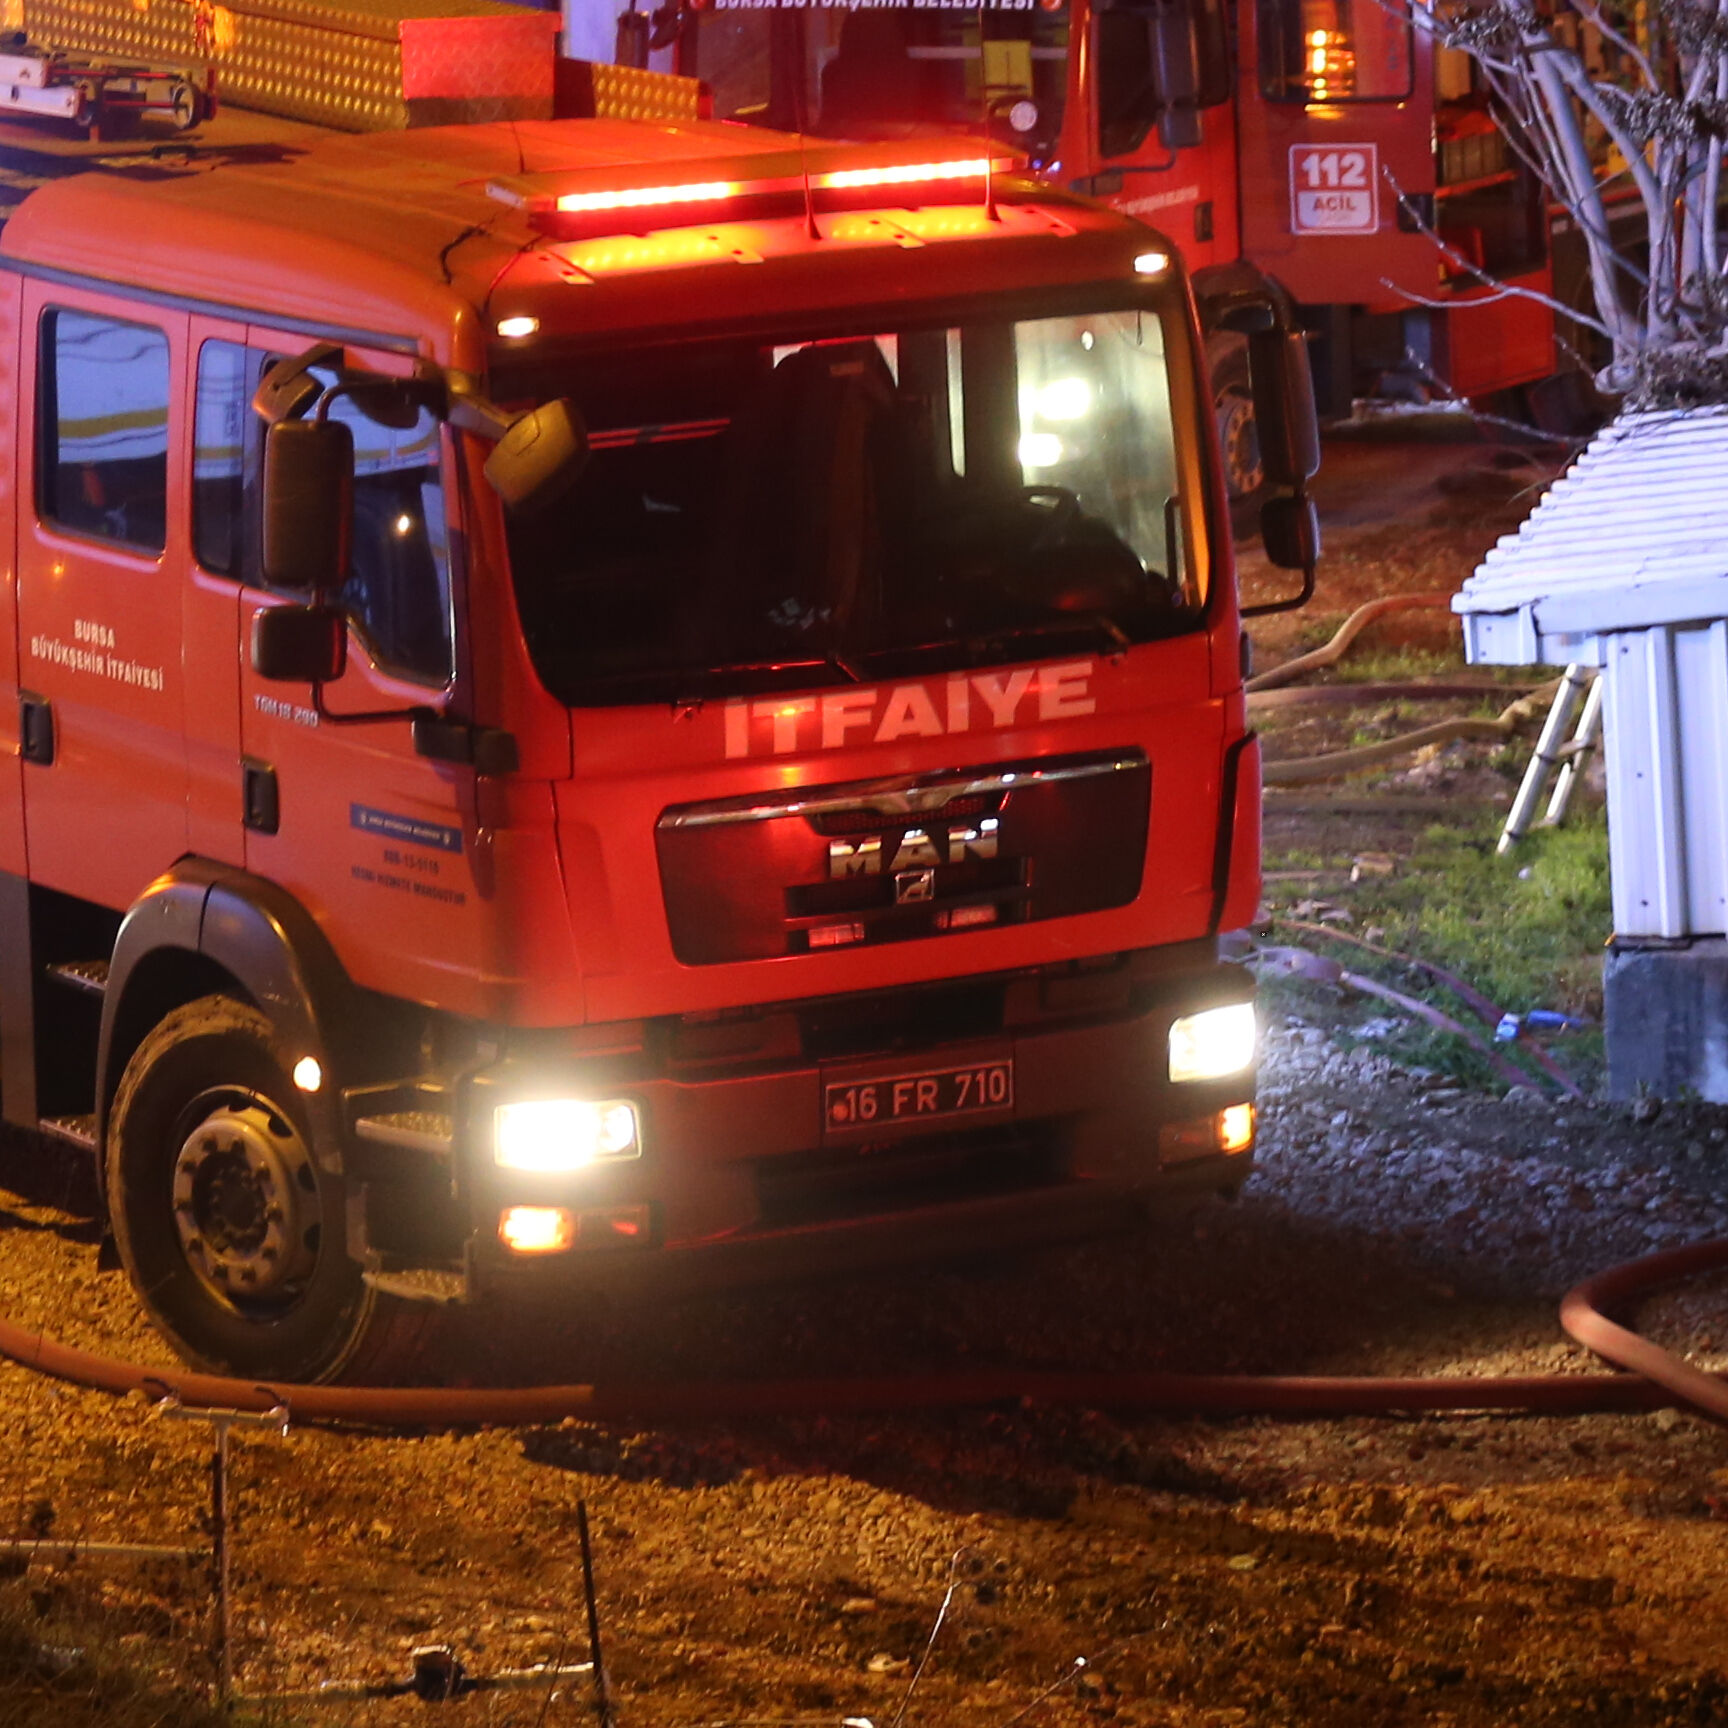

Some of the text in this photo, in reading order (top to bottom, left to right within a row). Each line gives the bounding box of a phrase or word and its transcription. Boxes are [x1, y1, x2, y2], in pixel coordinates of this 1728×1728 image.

[1301, 152, 1367, 188] 112
[74, 619, 116, 648] BURSA
[31, 634, 164, 692] BÜYÜKŞEHİR İTFAİYESİ
[724, 660, 1097, 760] İTFAİYE
[829, 818, 1000, 879] MAN
[845, 1068, 1008, 1123] 16 FR 710
